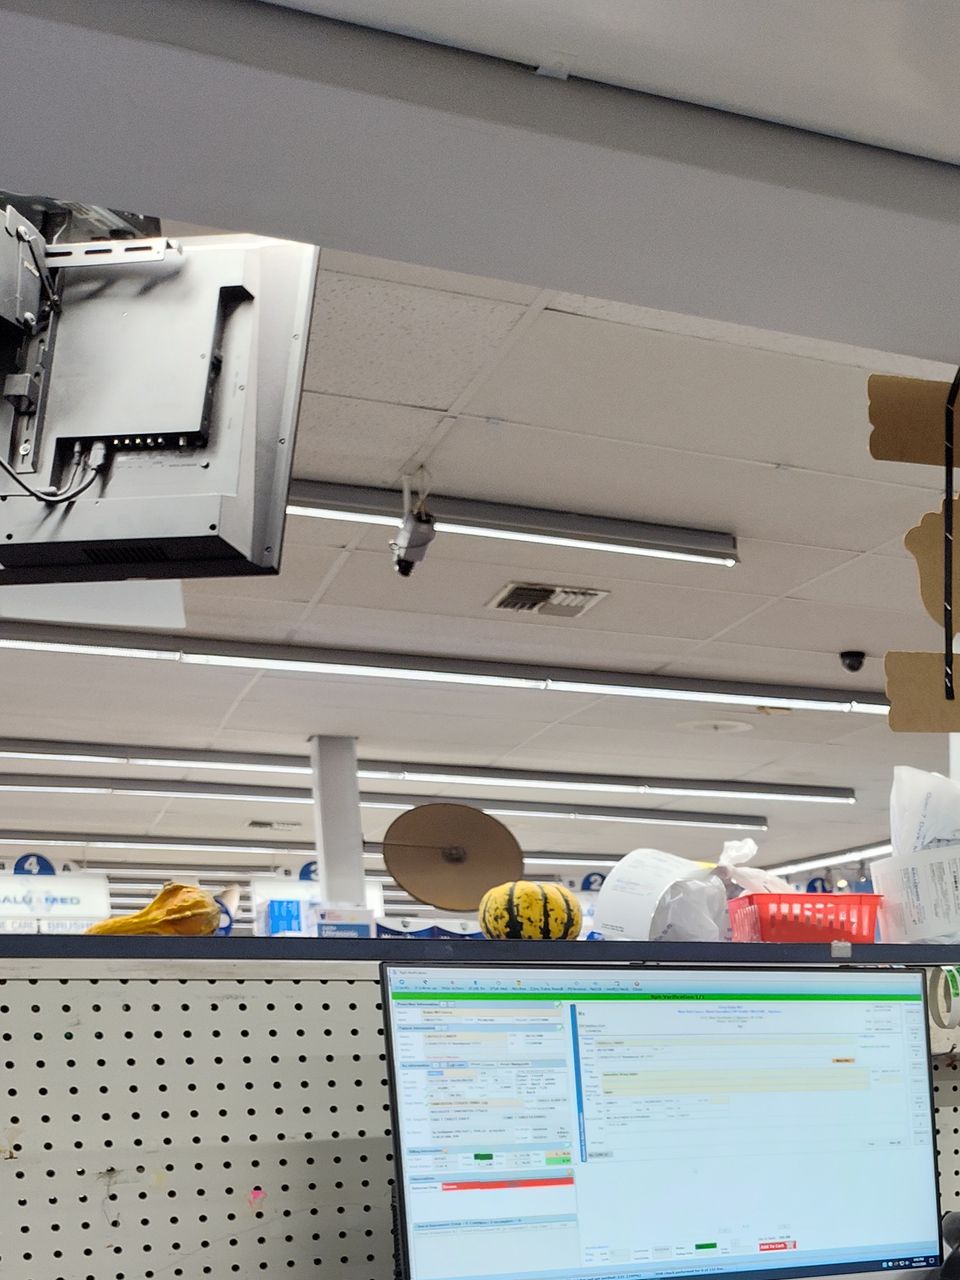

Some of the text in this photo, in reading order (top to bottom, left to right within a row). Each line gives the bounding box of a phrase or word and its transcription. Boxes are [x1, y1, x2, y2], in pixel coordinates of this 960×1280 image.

[24, 856, 40, 875] 4
[62, 863, 71, 872] A
[591, 876, 602, 891] 2
